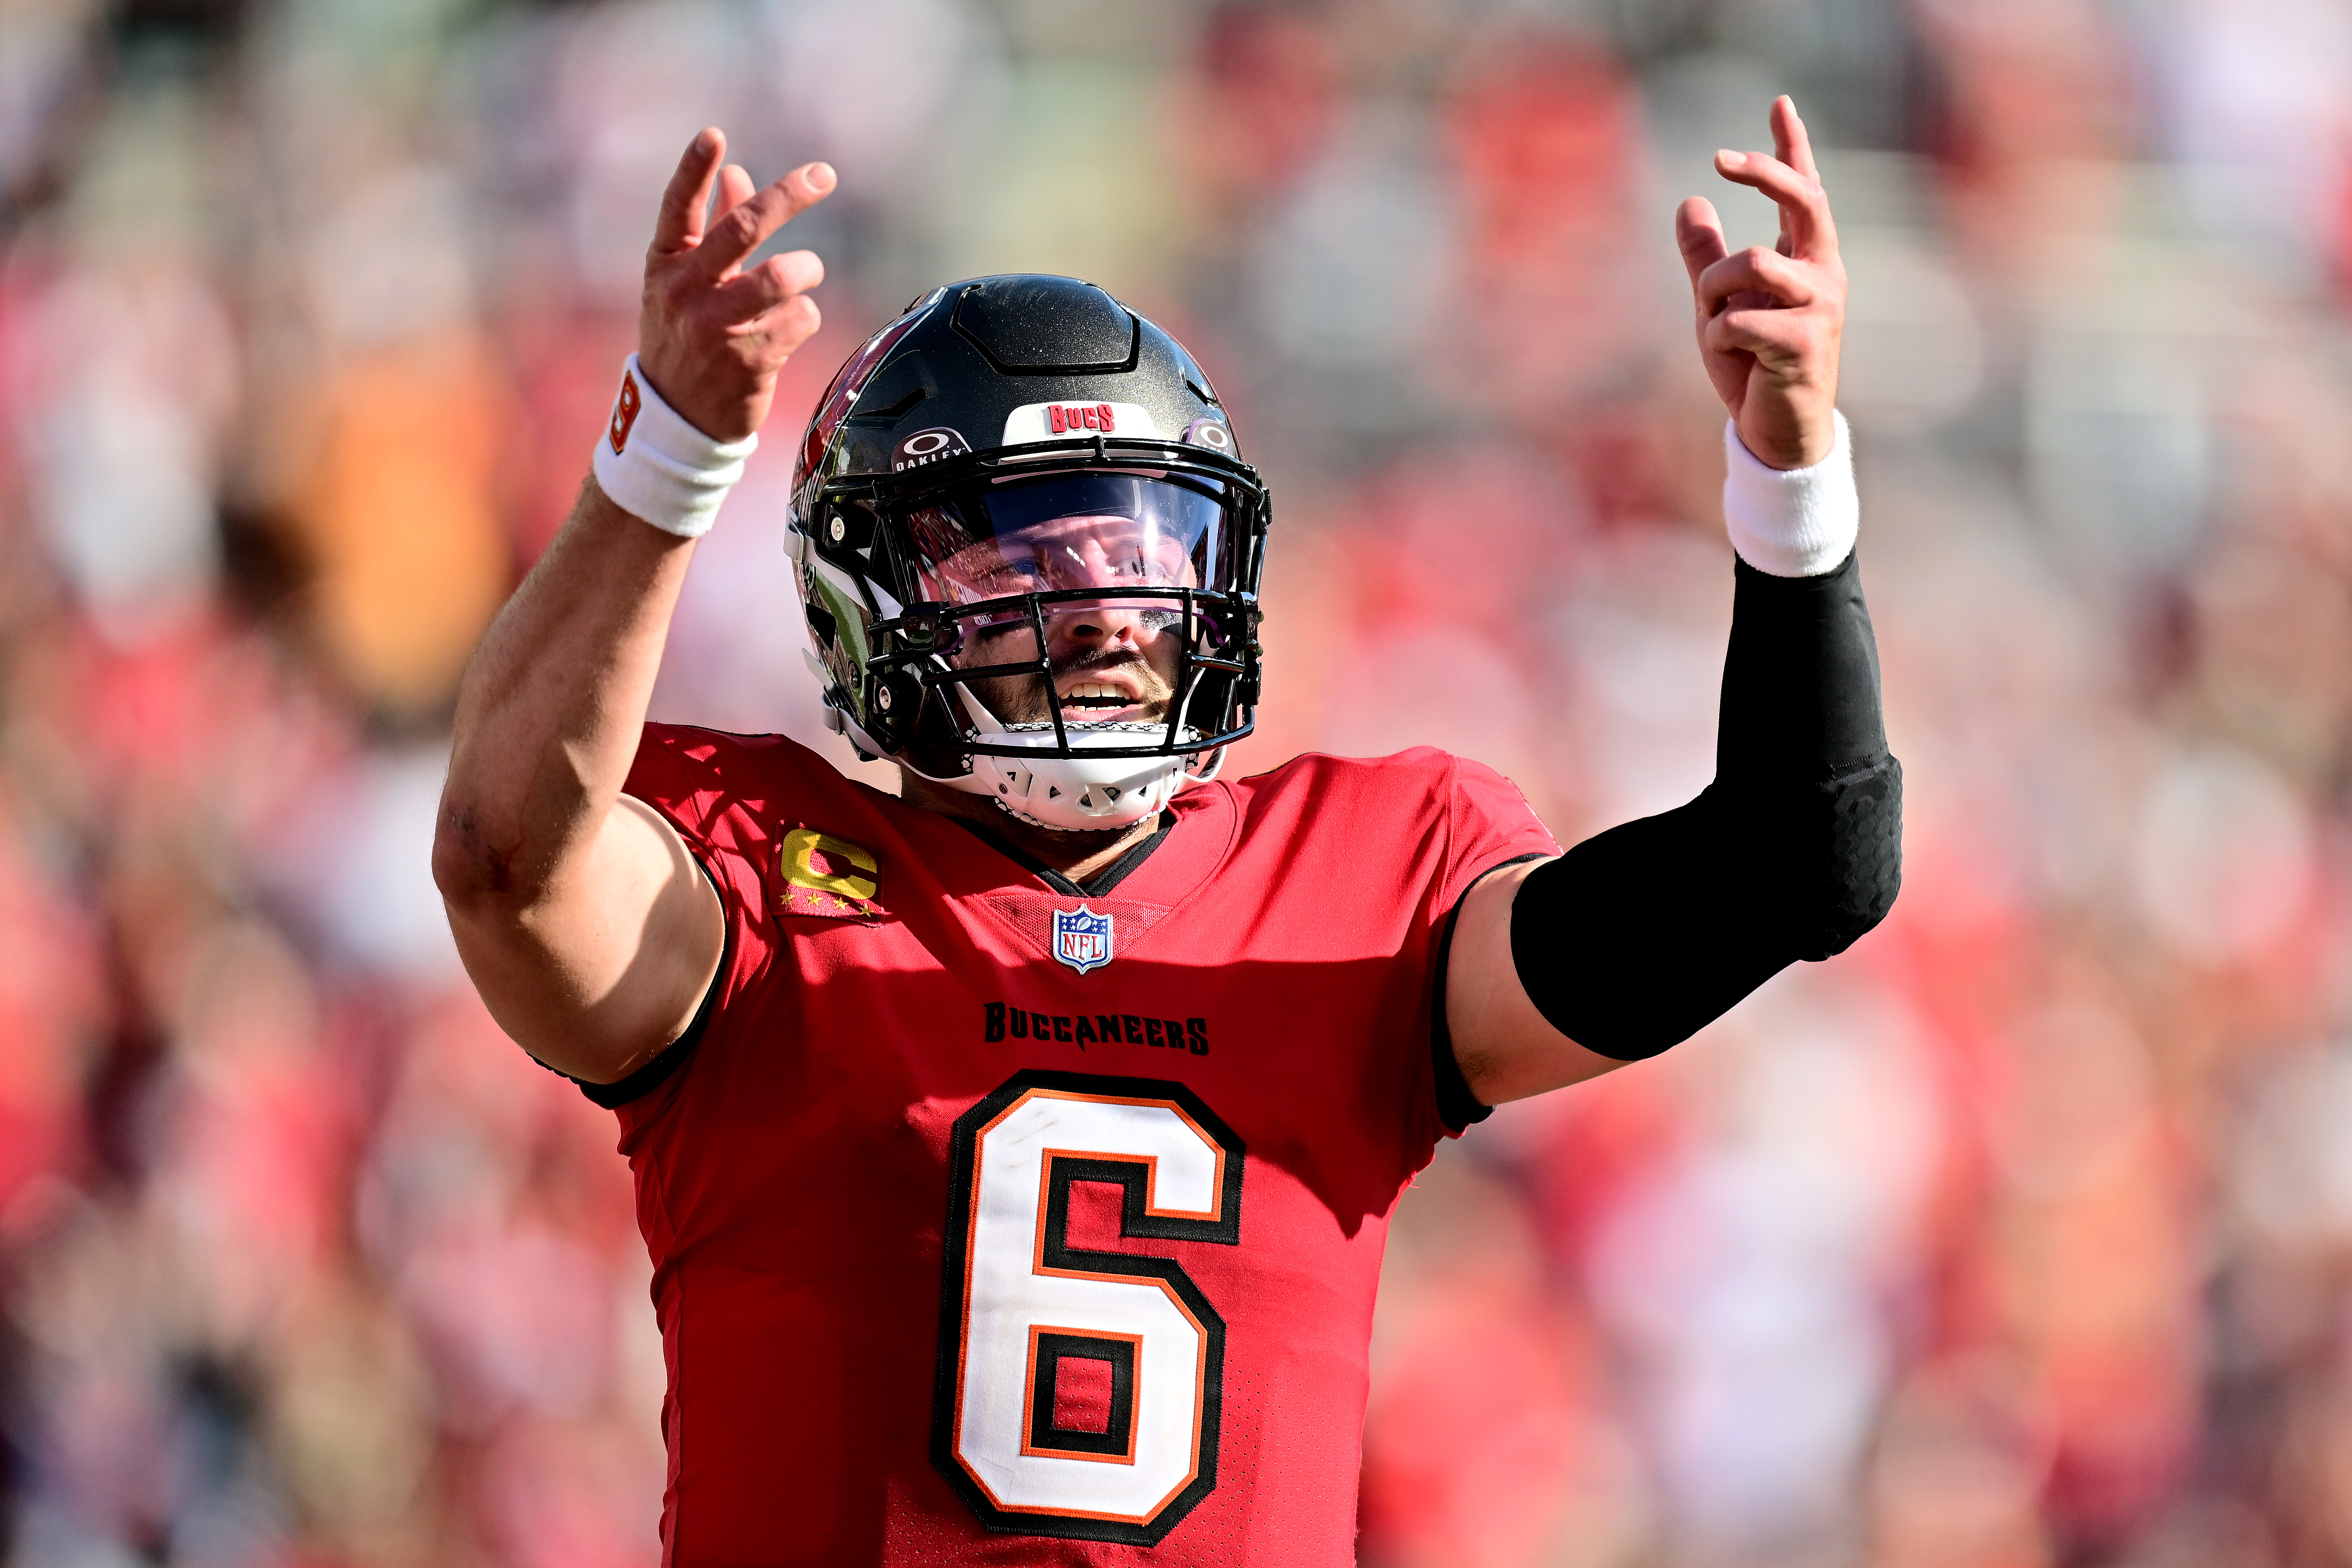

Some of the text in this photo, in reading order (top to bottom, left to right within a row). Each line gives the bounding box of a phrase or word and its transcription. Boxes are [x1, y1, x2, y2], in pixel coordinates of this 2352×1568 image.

[1047, 404, 1114, 434] BUCS
[781, 829, 877, 899] C
[1063, 934, 1102, 960] NFL
[983, 1002, 1209, 1055] BUCCANEERS
[930, 1068, 1246, 1546] 6
